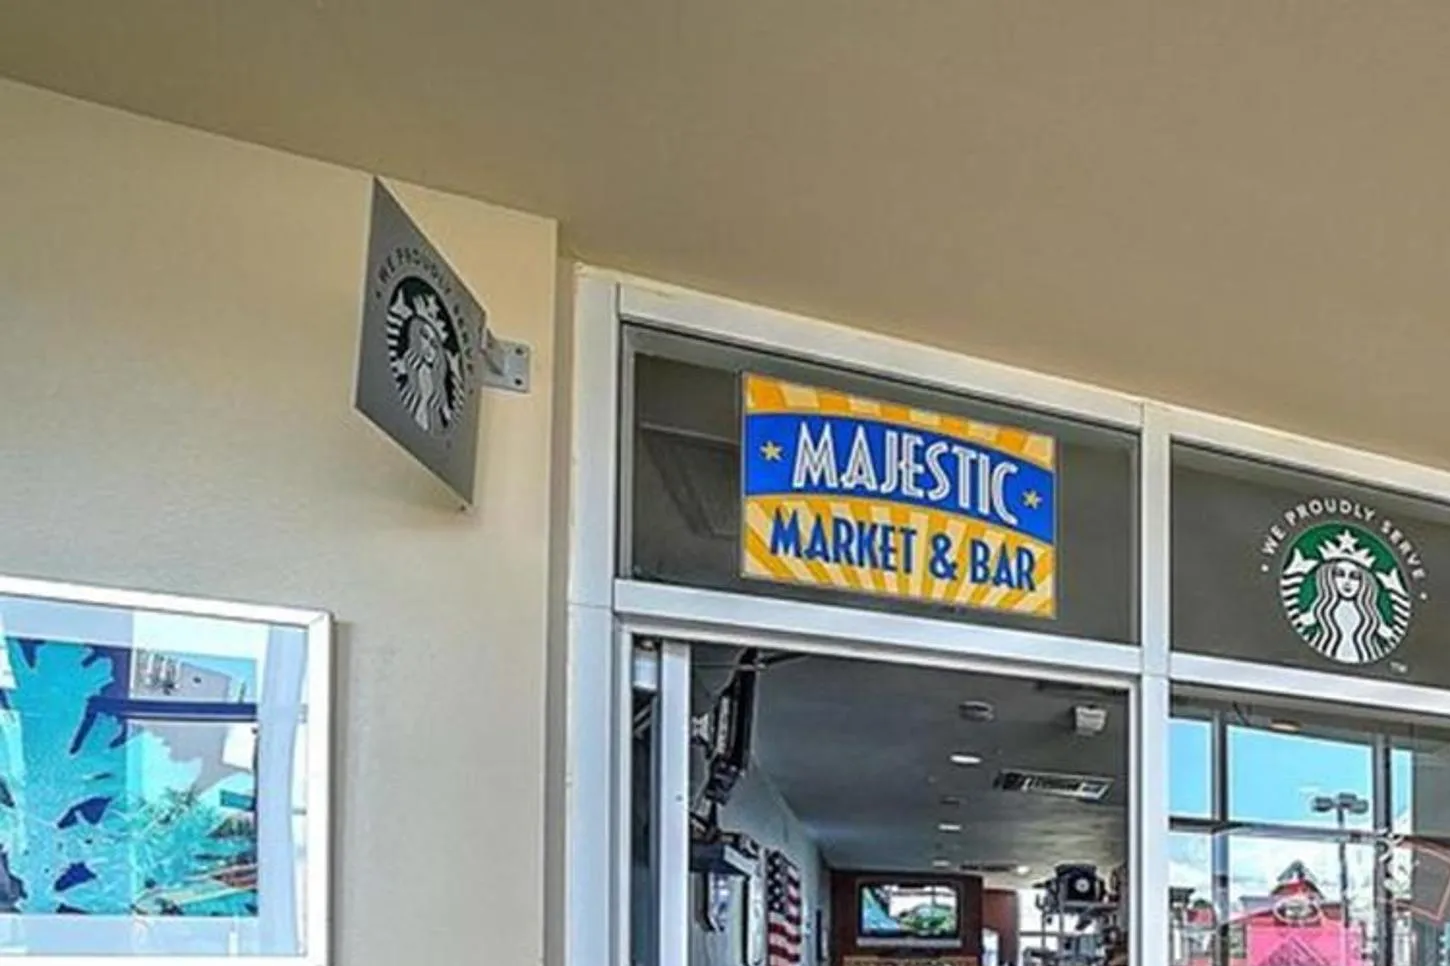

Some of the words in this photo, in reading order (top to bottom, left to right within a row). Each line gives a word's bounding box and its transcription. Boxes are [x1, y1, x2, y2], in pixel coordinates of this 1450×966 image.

[792, 421, 1019, 526] MAJESTIC
[770, 505, 917, 574] MARKET
[929, 532, 958, 582] &
[969, 538, 1036, 593] BAR
[1262, 524, 1287, 556] WE
[1284, 498, 1376, 527] PROUDLY
[1380, 519, 1426, 579] SERVE
